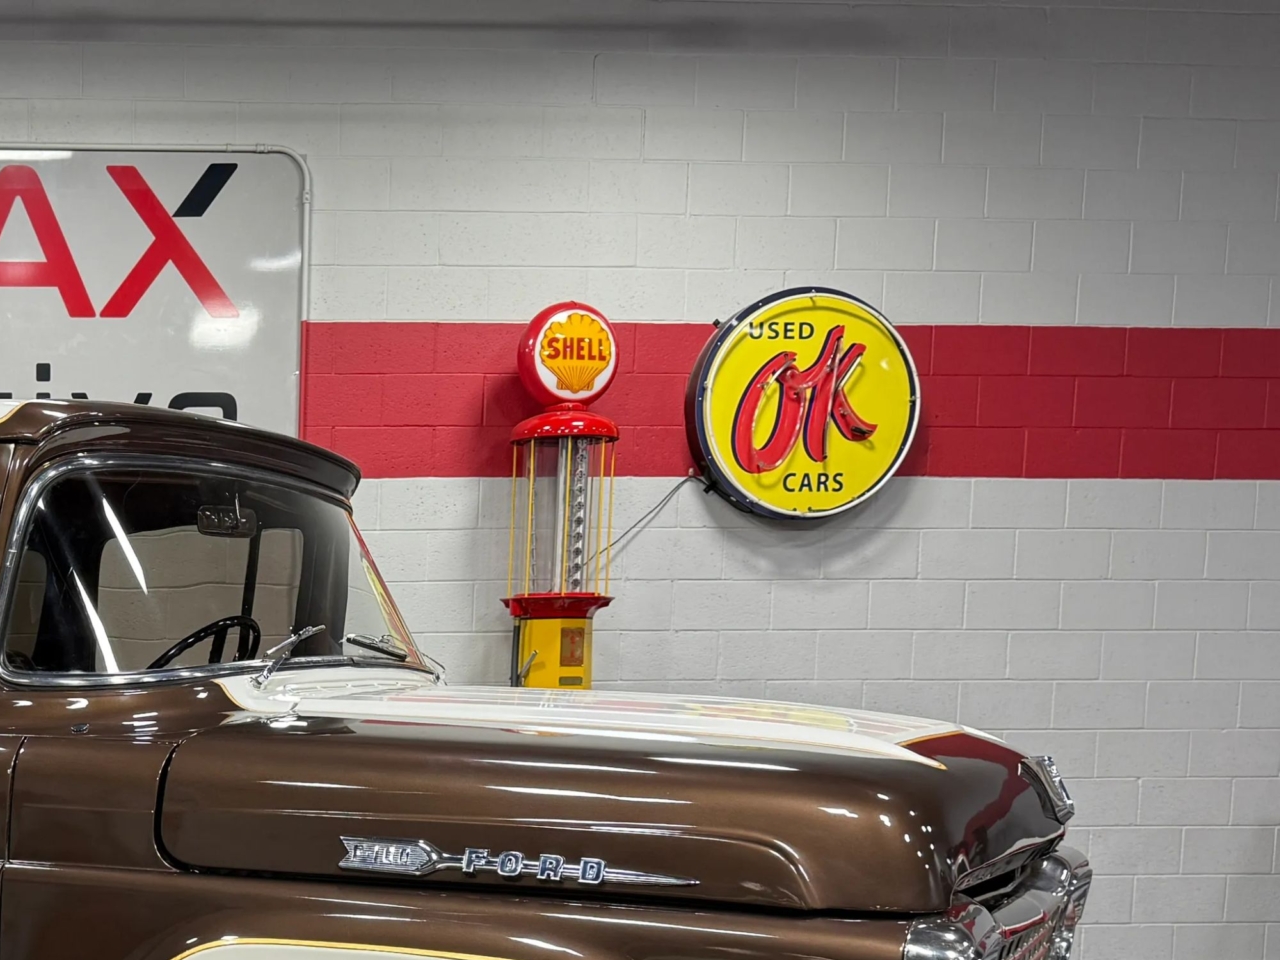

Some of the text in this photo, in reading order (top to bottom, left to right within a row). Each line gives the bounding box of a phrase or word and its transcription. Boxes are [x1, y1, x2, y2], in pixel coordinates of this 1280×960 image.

[747, 321, 815, 341] USED
[546, 336, 607, 361] SHELL
[731, 324, 878, 474] OK
[782, 472, 844, 494] CARS
[462, 847, 607, 884] FORD
